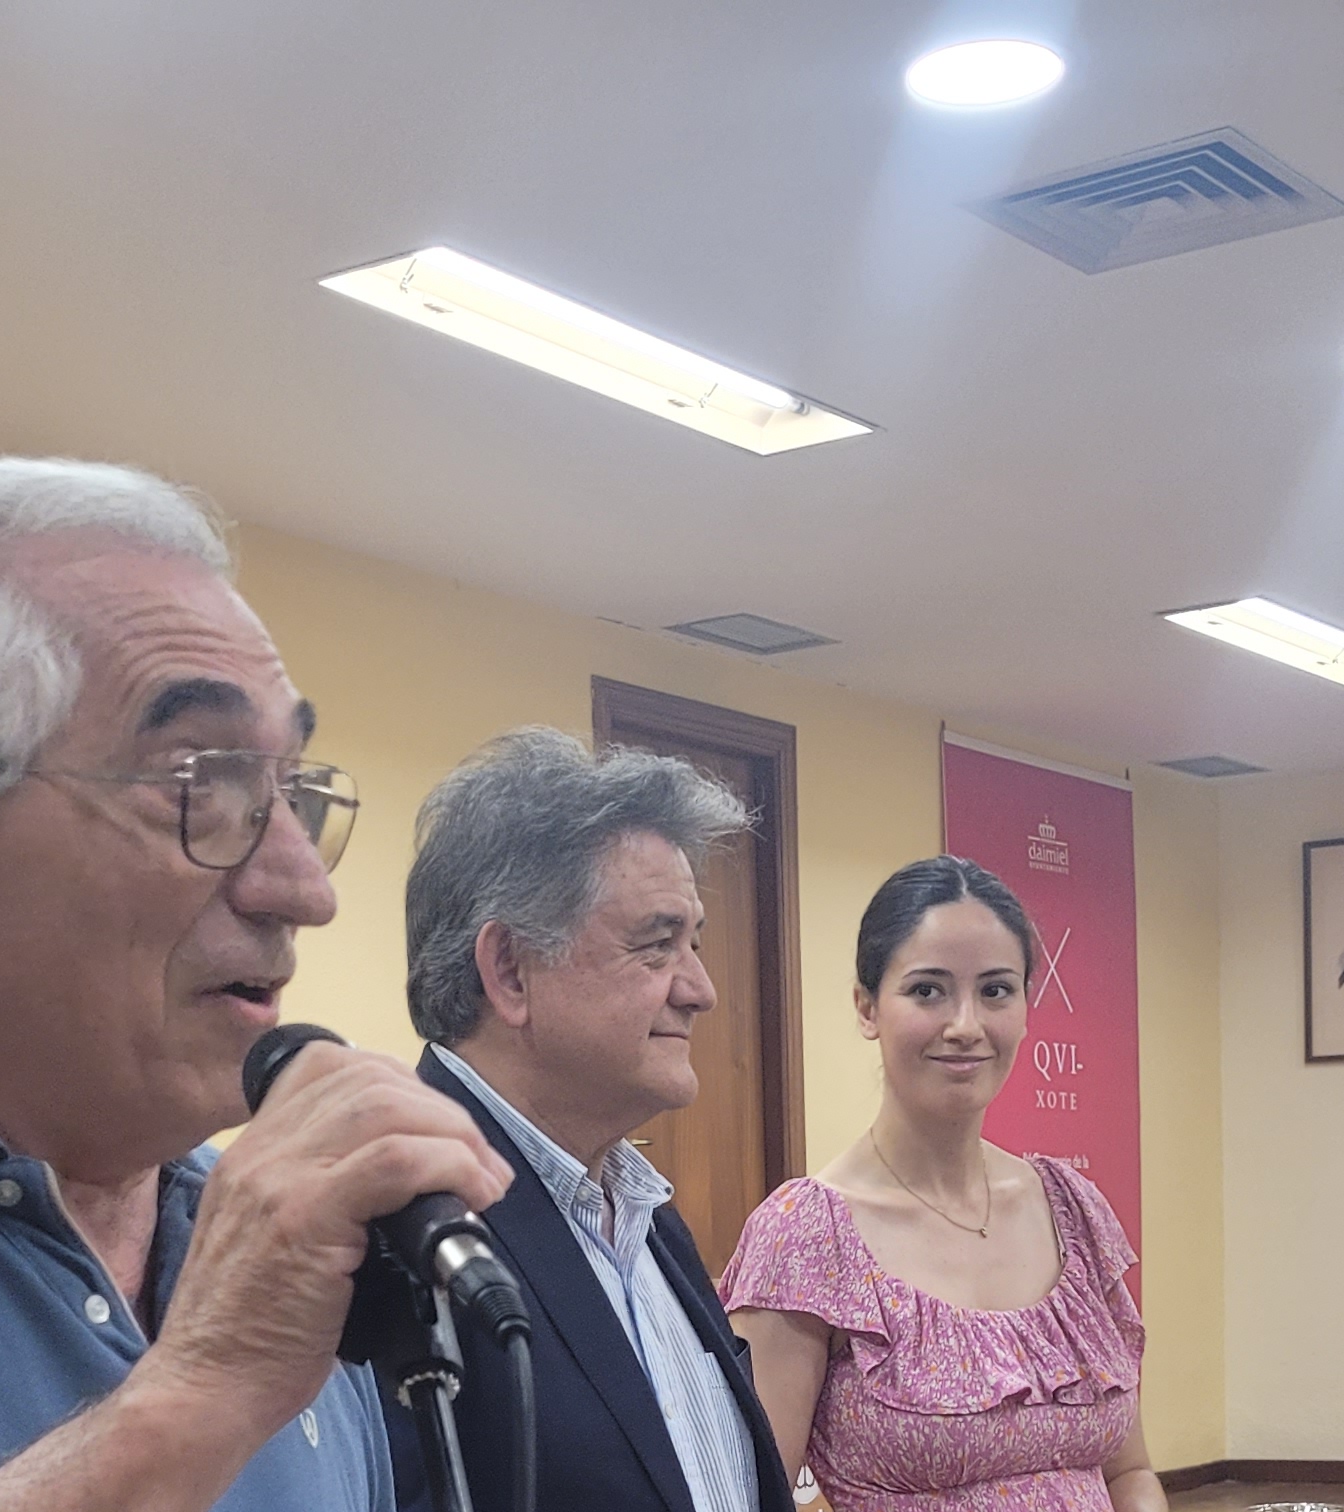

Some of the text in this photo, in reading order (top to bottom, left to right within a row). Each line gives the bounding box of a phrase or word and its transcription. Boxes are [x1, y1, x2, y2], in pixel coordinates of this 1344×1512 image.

[1028, 841, 1070, 866] daimiel
[1033, 1040, 1084, 1082] QVI-
[1035, 1090, 1078, 1111] XOTE
